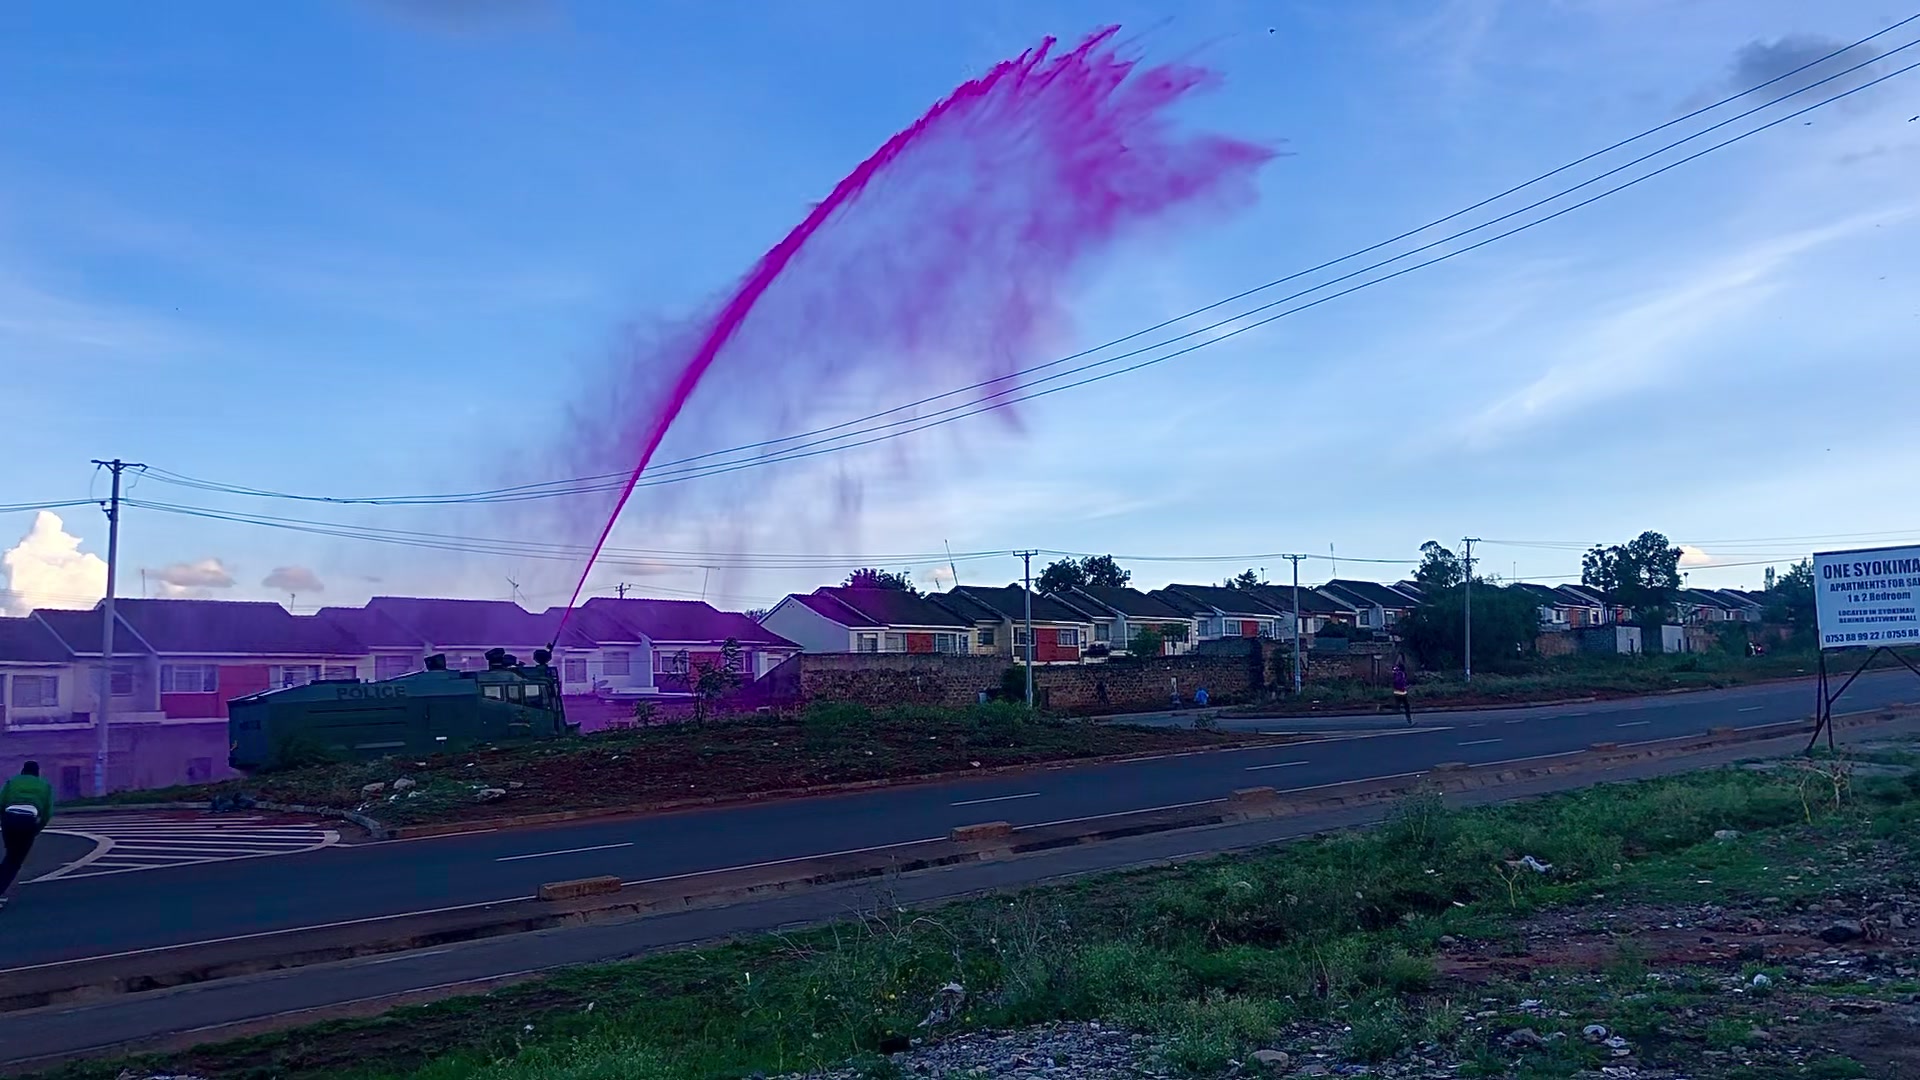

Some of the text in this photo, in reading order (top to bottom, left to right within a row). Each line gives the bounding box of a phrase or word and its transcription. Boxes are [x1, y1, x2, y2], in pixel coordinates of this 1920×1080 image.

[1823, 558, 1920, 579] ONE SYOKIMA
[1830, 580, 1886, 592] APARTMENTS
[1888, 578, 1905, 588] FOR
[1861, 593, 1868, 602] 2
[1869, 591, 1911, 601] Bedroom
[1825, 634, 1844, 643] 0753
[1869, 631, 1880, 640] 22
[336, 685, 406, 701] POLICE
